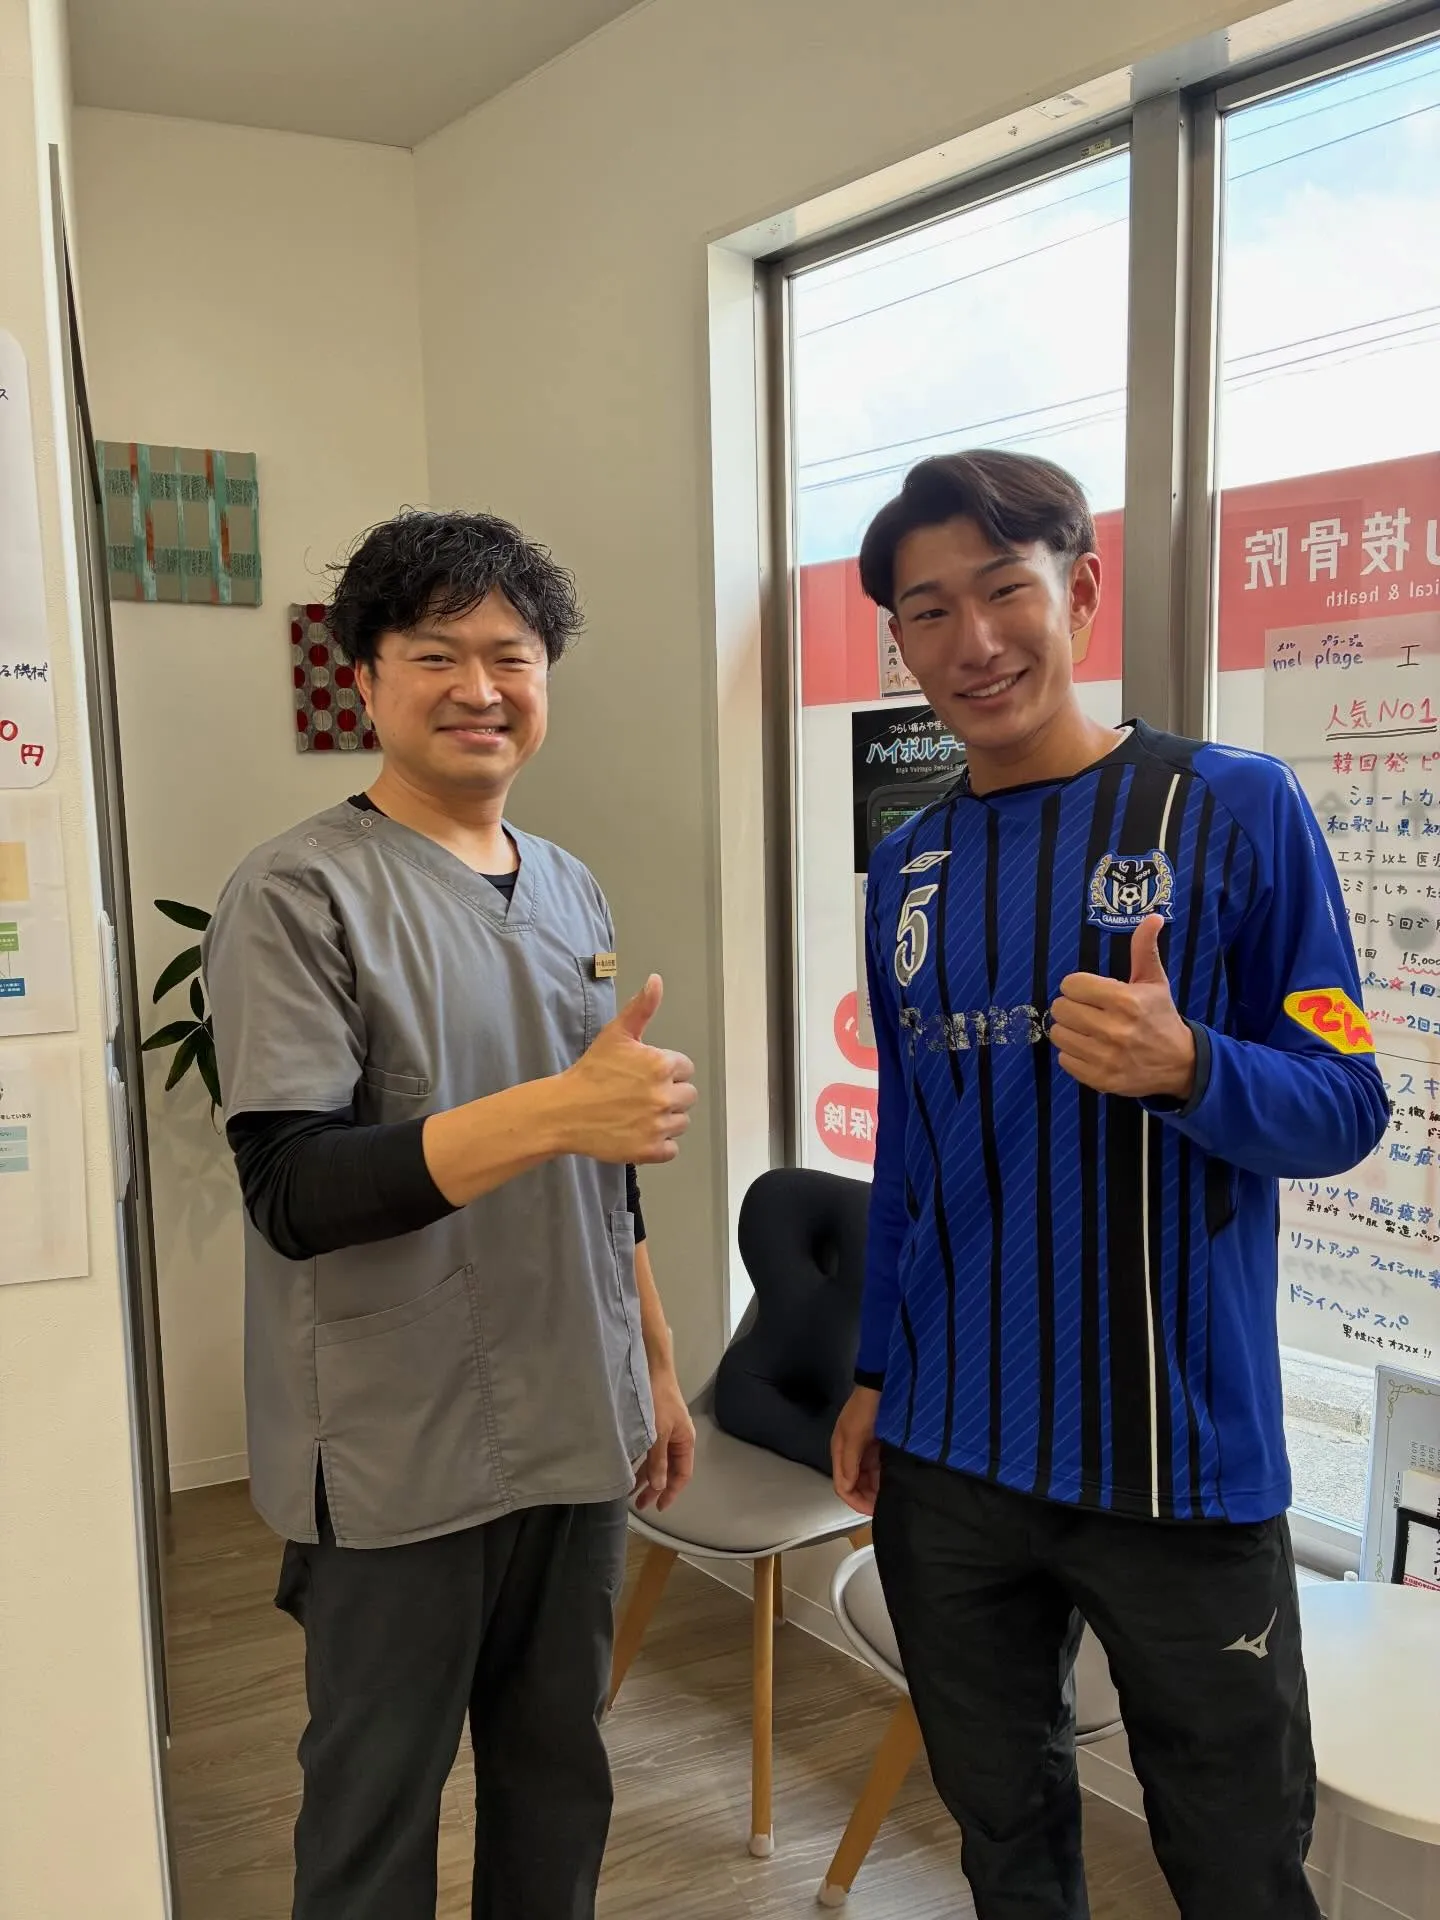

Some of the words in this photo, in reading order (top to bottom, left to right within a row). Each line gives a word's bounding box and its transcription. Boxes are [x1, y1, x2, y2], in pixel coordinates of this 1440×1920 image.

[1273, 650, 1302, 672] mel
[1315, 648, 1364, 670] plage
[1350, 785, 1440, 807] ショートカ
[1343, 878, 1440, 899] シミ・しわ・た
[1129, 914, 1146, 924] OSA
[894, 883, 939, 987] 5
[1410, 980, 1440, 998] 1回
